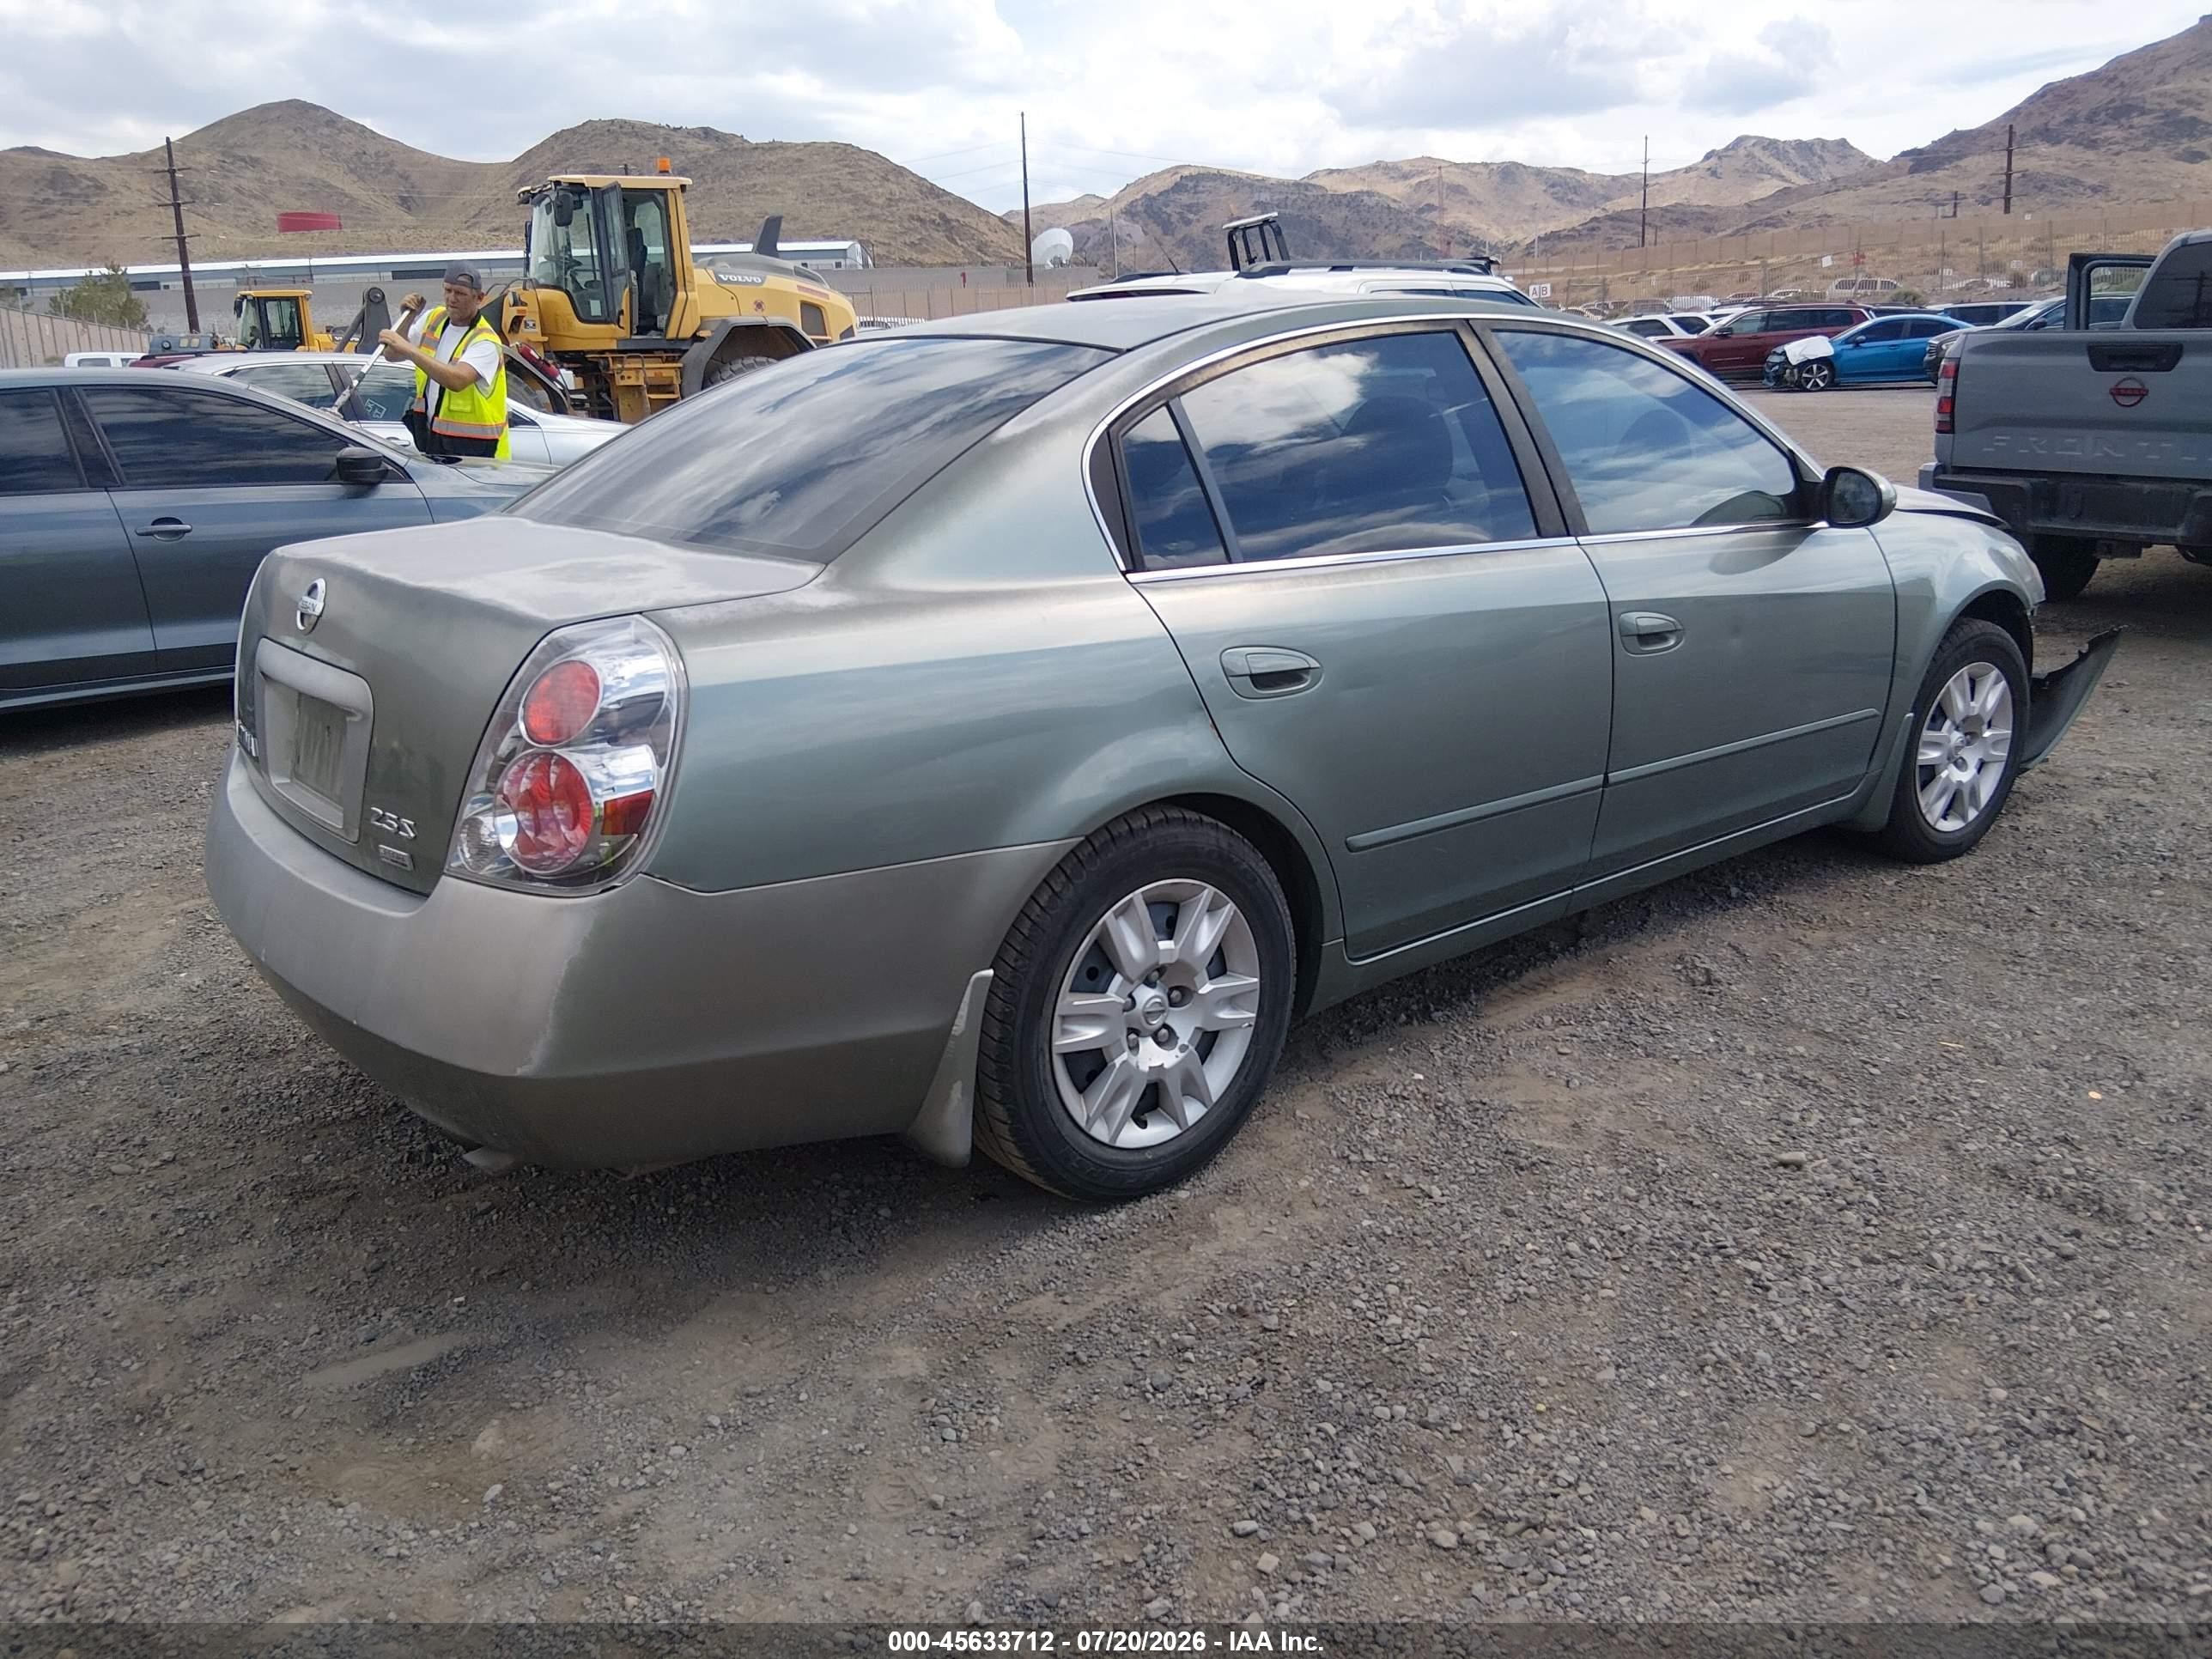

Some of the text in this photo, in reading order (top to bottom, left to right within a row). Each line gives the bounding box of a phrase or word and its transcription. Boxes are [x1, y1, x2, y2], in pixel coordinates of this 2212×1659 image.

[718, 274, 763, 283] VOLVO
[1531, 286, 1547, 297] A B
